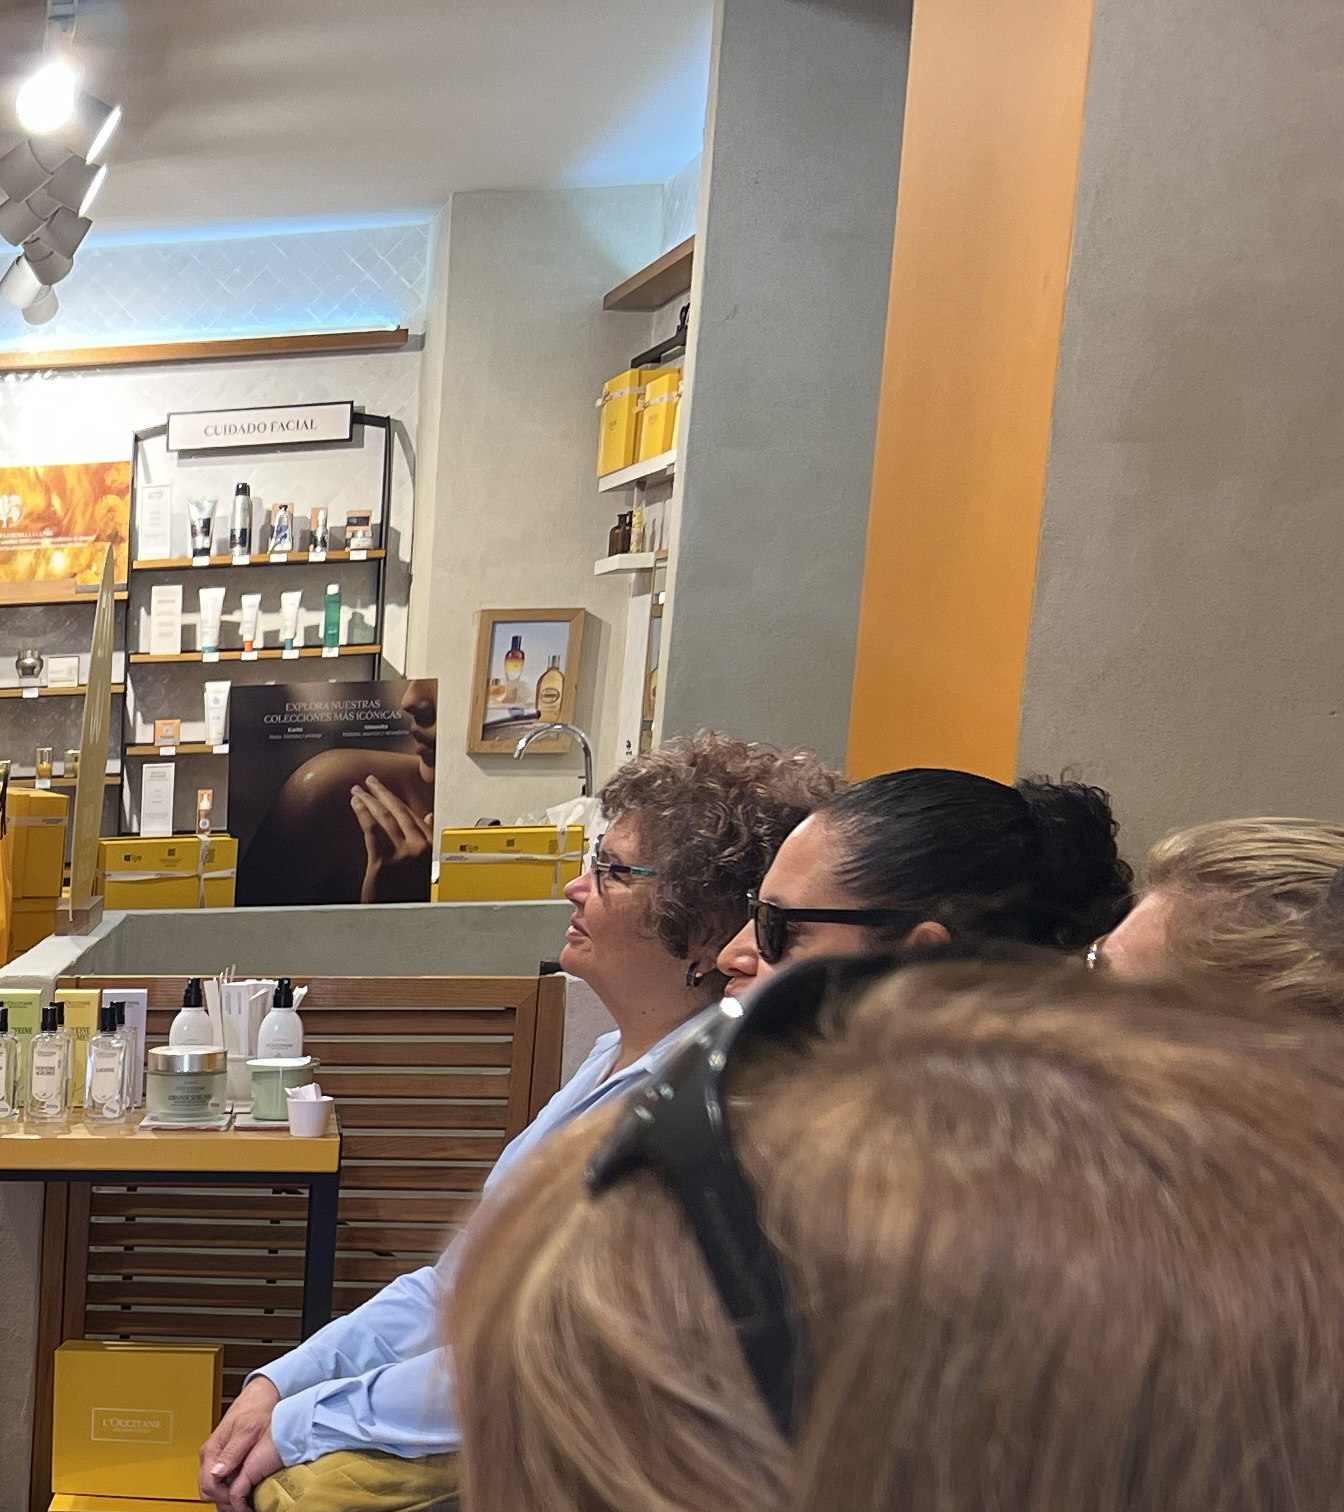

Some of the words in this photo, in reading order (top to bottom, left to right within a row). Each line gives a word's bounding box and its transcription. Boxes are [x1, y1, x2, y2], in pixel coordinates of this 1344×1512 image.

[204, 422, 267, 436] CUIDADO
[271, 419, 318, 432] FACIAL
[285, 702, 330, 712] EXPLORA
[332, 699, 381, 710] NUESTRAS
[264, 712, 332, 724] COLECCIONES
[333, 710, 355, 721] MÁS
[356, 709, 402, 721] ICÓNICAS
